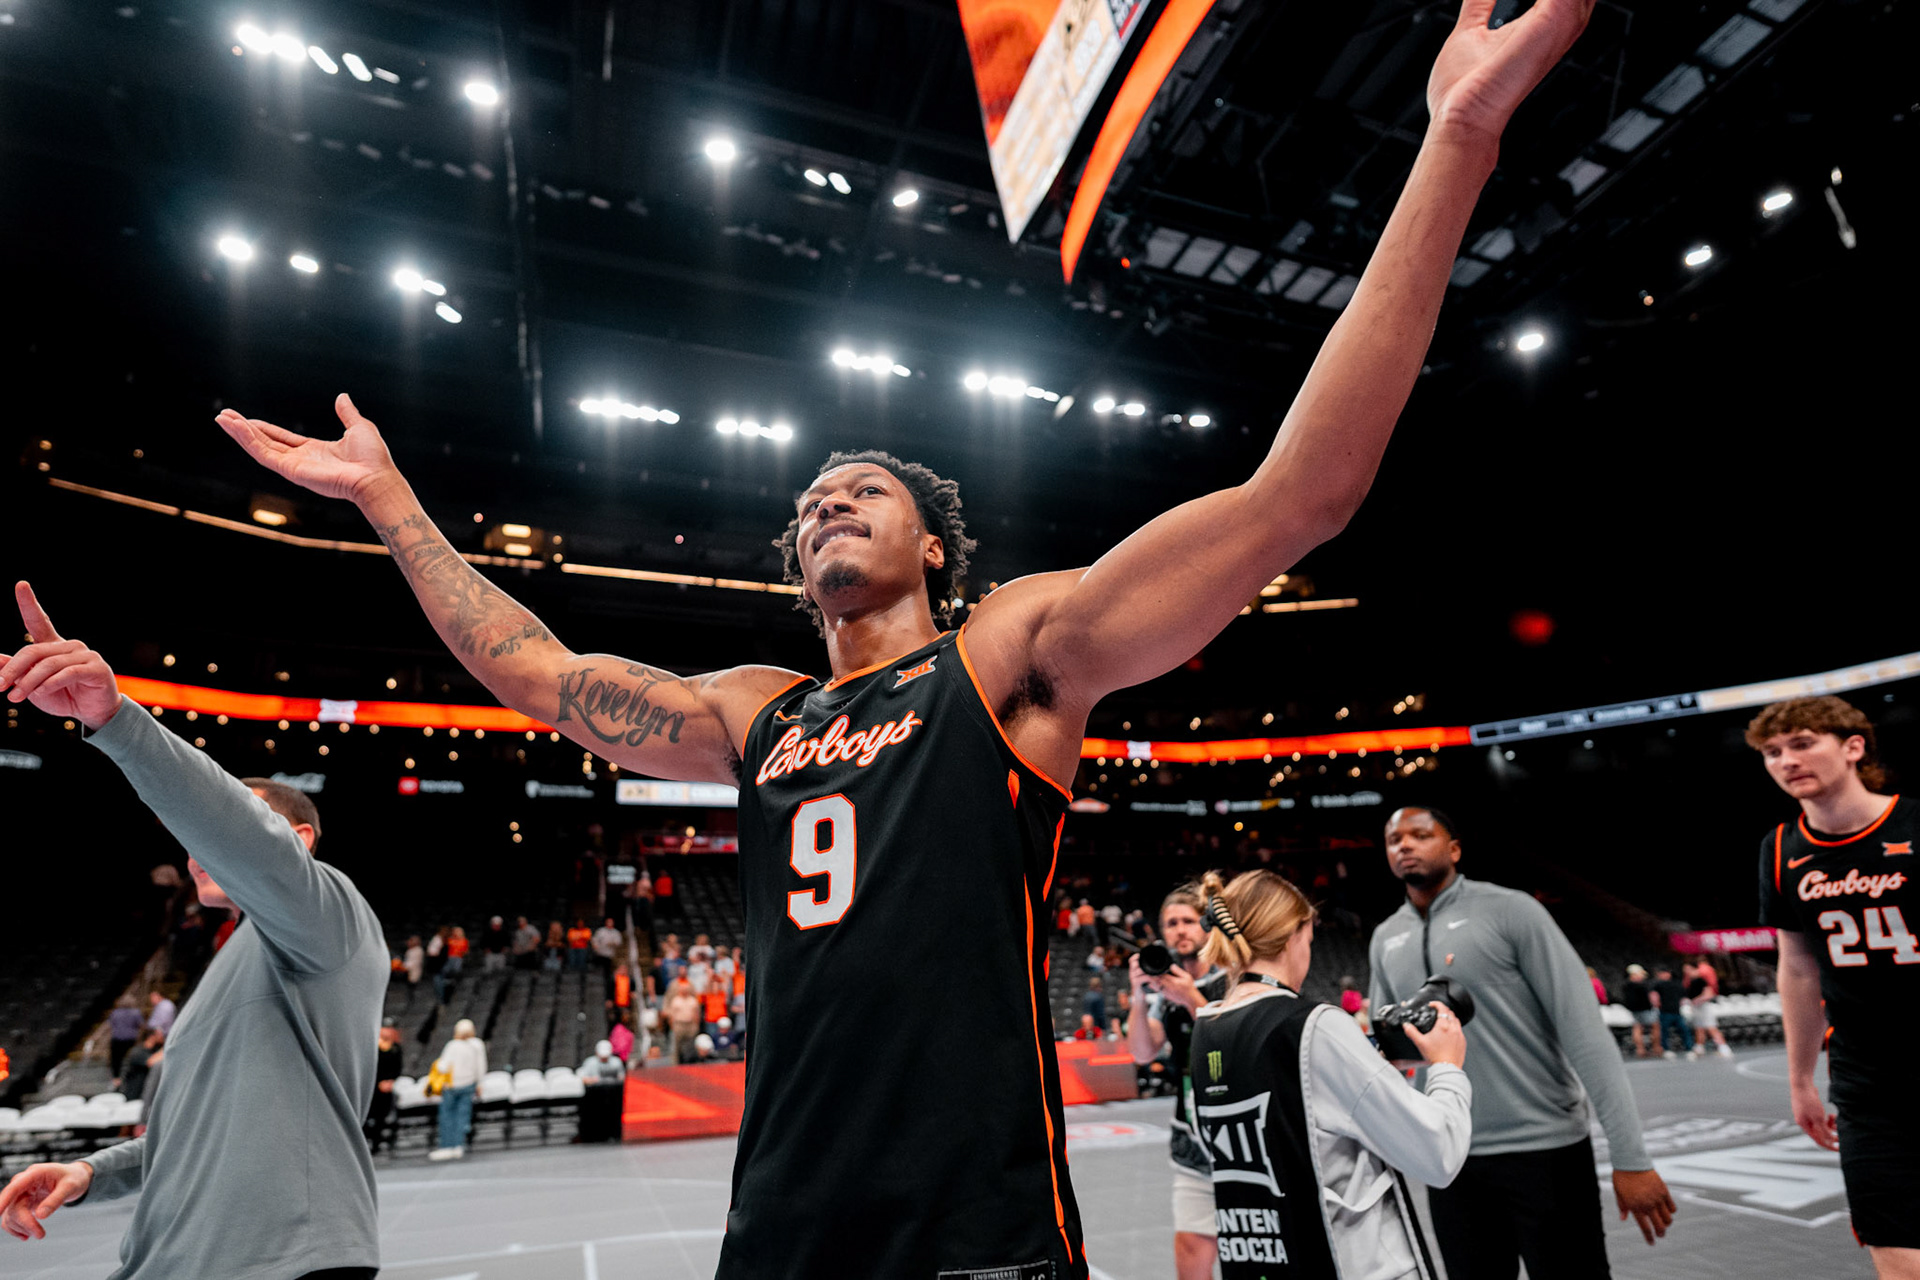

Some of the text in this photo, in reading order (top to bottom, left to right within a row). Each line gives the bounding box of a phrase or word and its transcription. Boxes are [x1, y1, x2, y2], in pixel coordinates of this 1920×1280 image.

[490, 635, 521, 658] Live
[556, 667, 686, 747] Kaelyn
[755, 710, 923, 786] Cowboys
[786, 792, 858, 931] 9
[1797, 868, 1908, 901] Cowboys
[1817, 905, 1920, 967] 24
[1218, 1237, 1289, 1264] SOCIA
